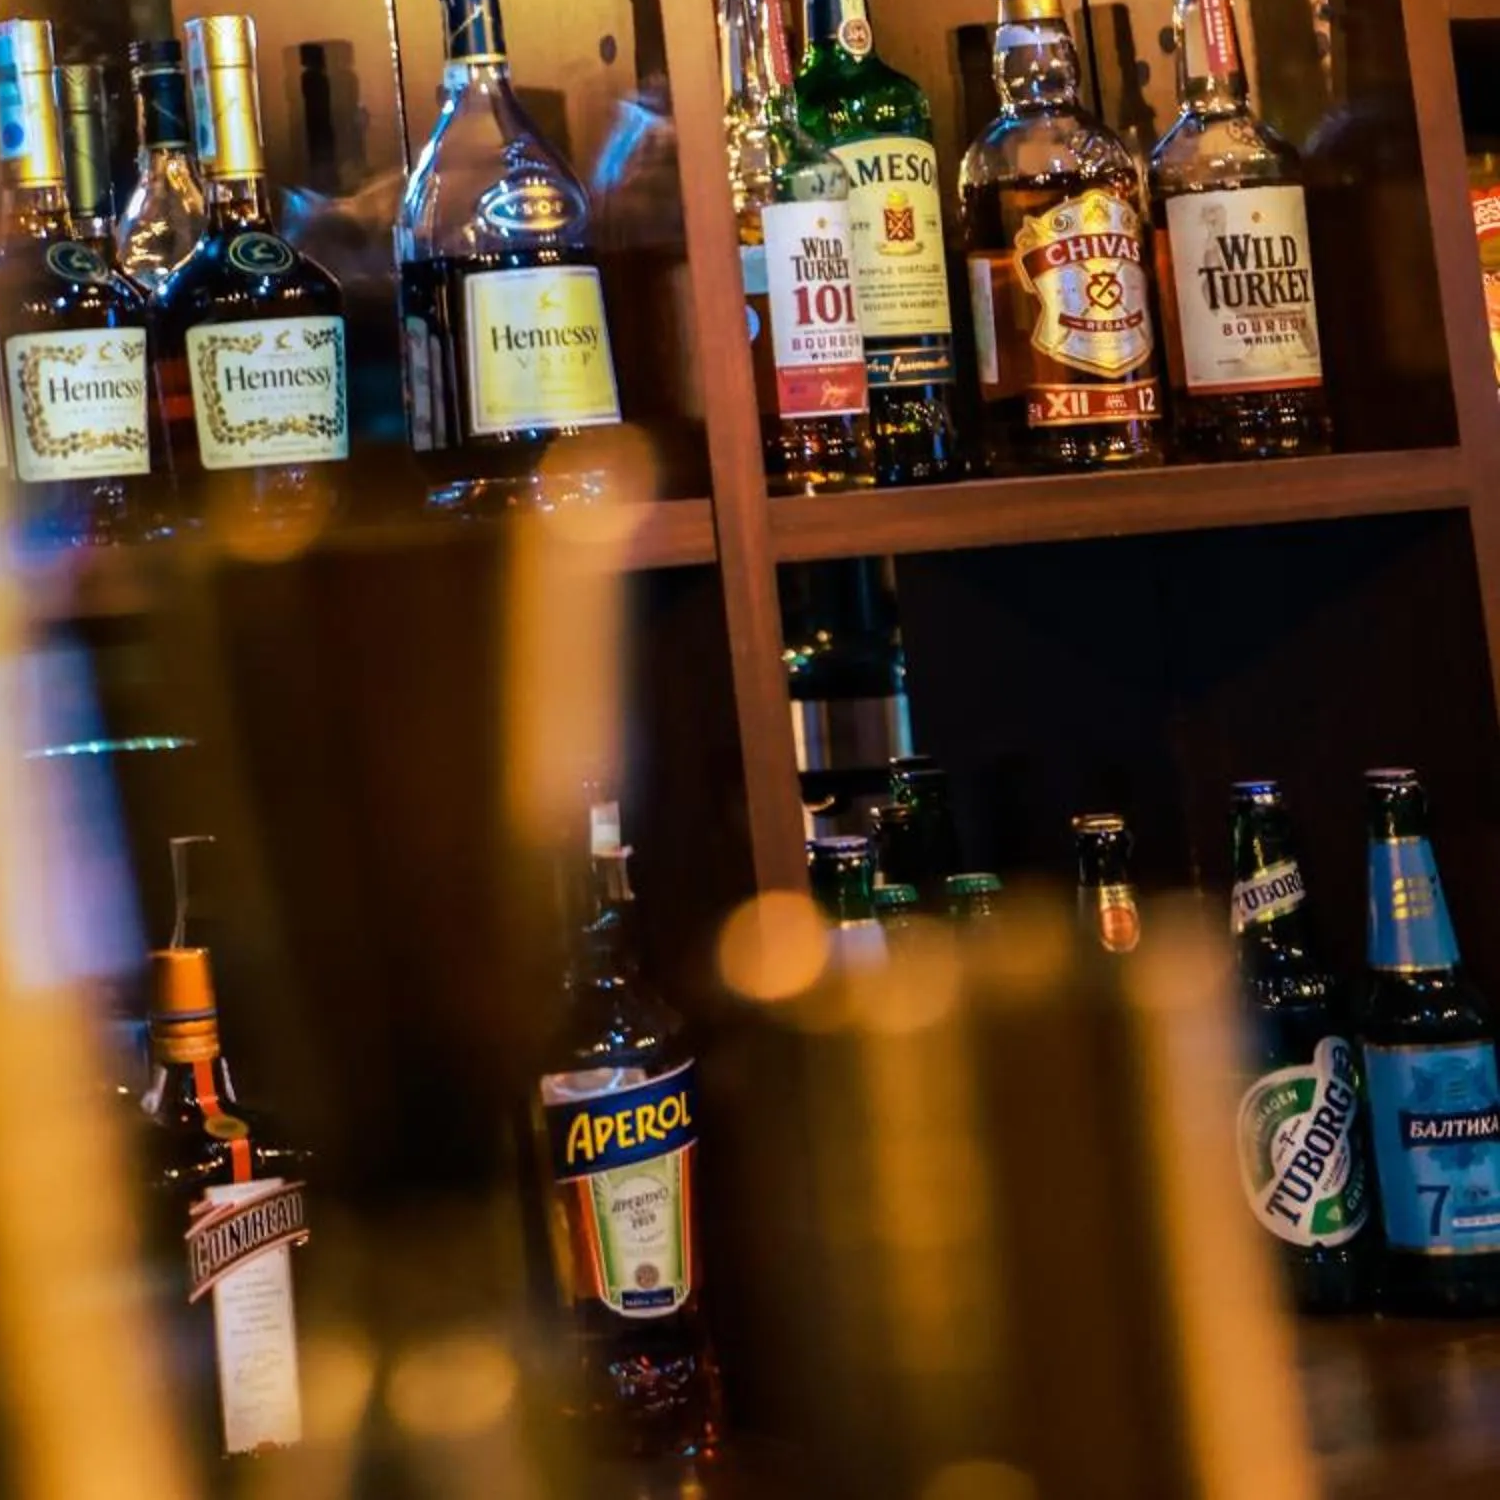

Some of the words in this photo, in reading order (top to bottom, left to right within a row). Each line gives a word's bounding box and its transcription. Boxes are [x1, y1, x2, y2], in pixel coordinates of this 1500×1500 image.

[801, 237, 844, 259] WILD
[1045, 235, 1140, 265] CHIVAS
[1217, 233, 1298, 272] WILD
[790, 255, 850, 283] TURKEY
[793, 283, 856, 327] 101
[1198, 267, 1313, 311] TURKEY
[491, 323, 599, 352] Hennessy
[225, 365, 332, 392] Hennessy
[1045, 390, 1090, 418] XII
[1137, 387, 1156, 413] 12
[1237, 867, 1301, 911] UBOR
[566, 1091, 692, 1165] APEROL
[1409, 1114, 1499, 1139] БАЛТИКА
[1266, 1078, 1357, 1227] TUBORG
[1416, 1185, 1451, 1237] 7
[192, 1192, 304, 1285] COINTREAU
